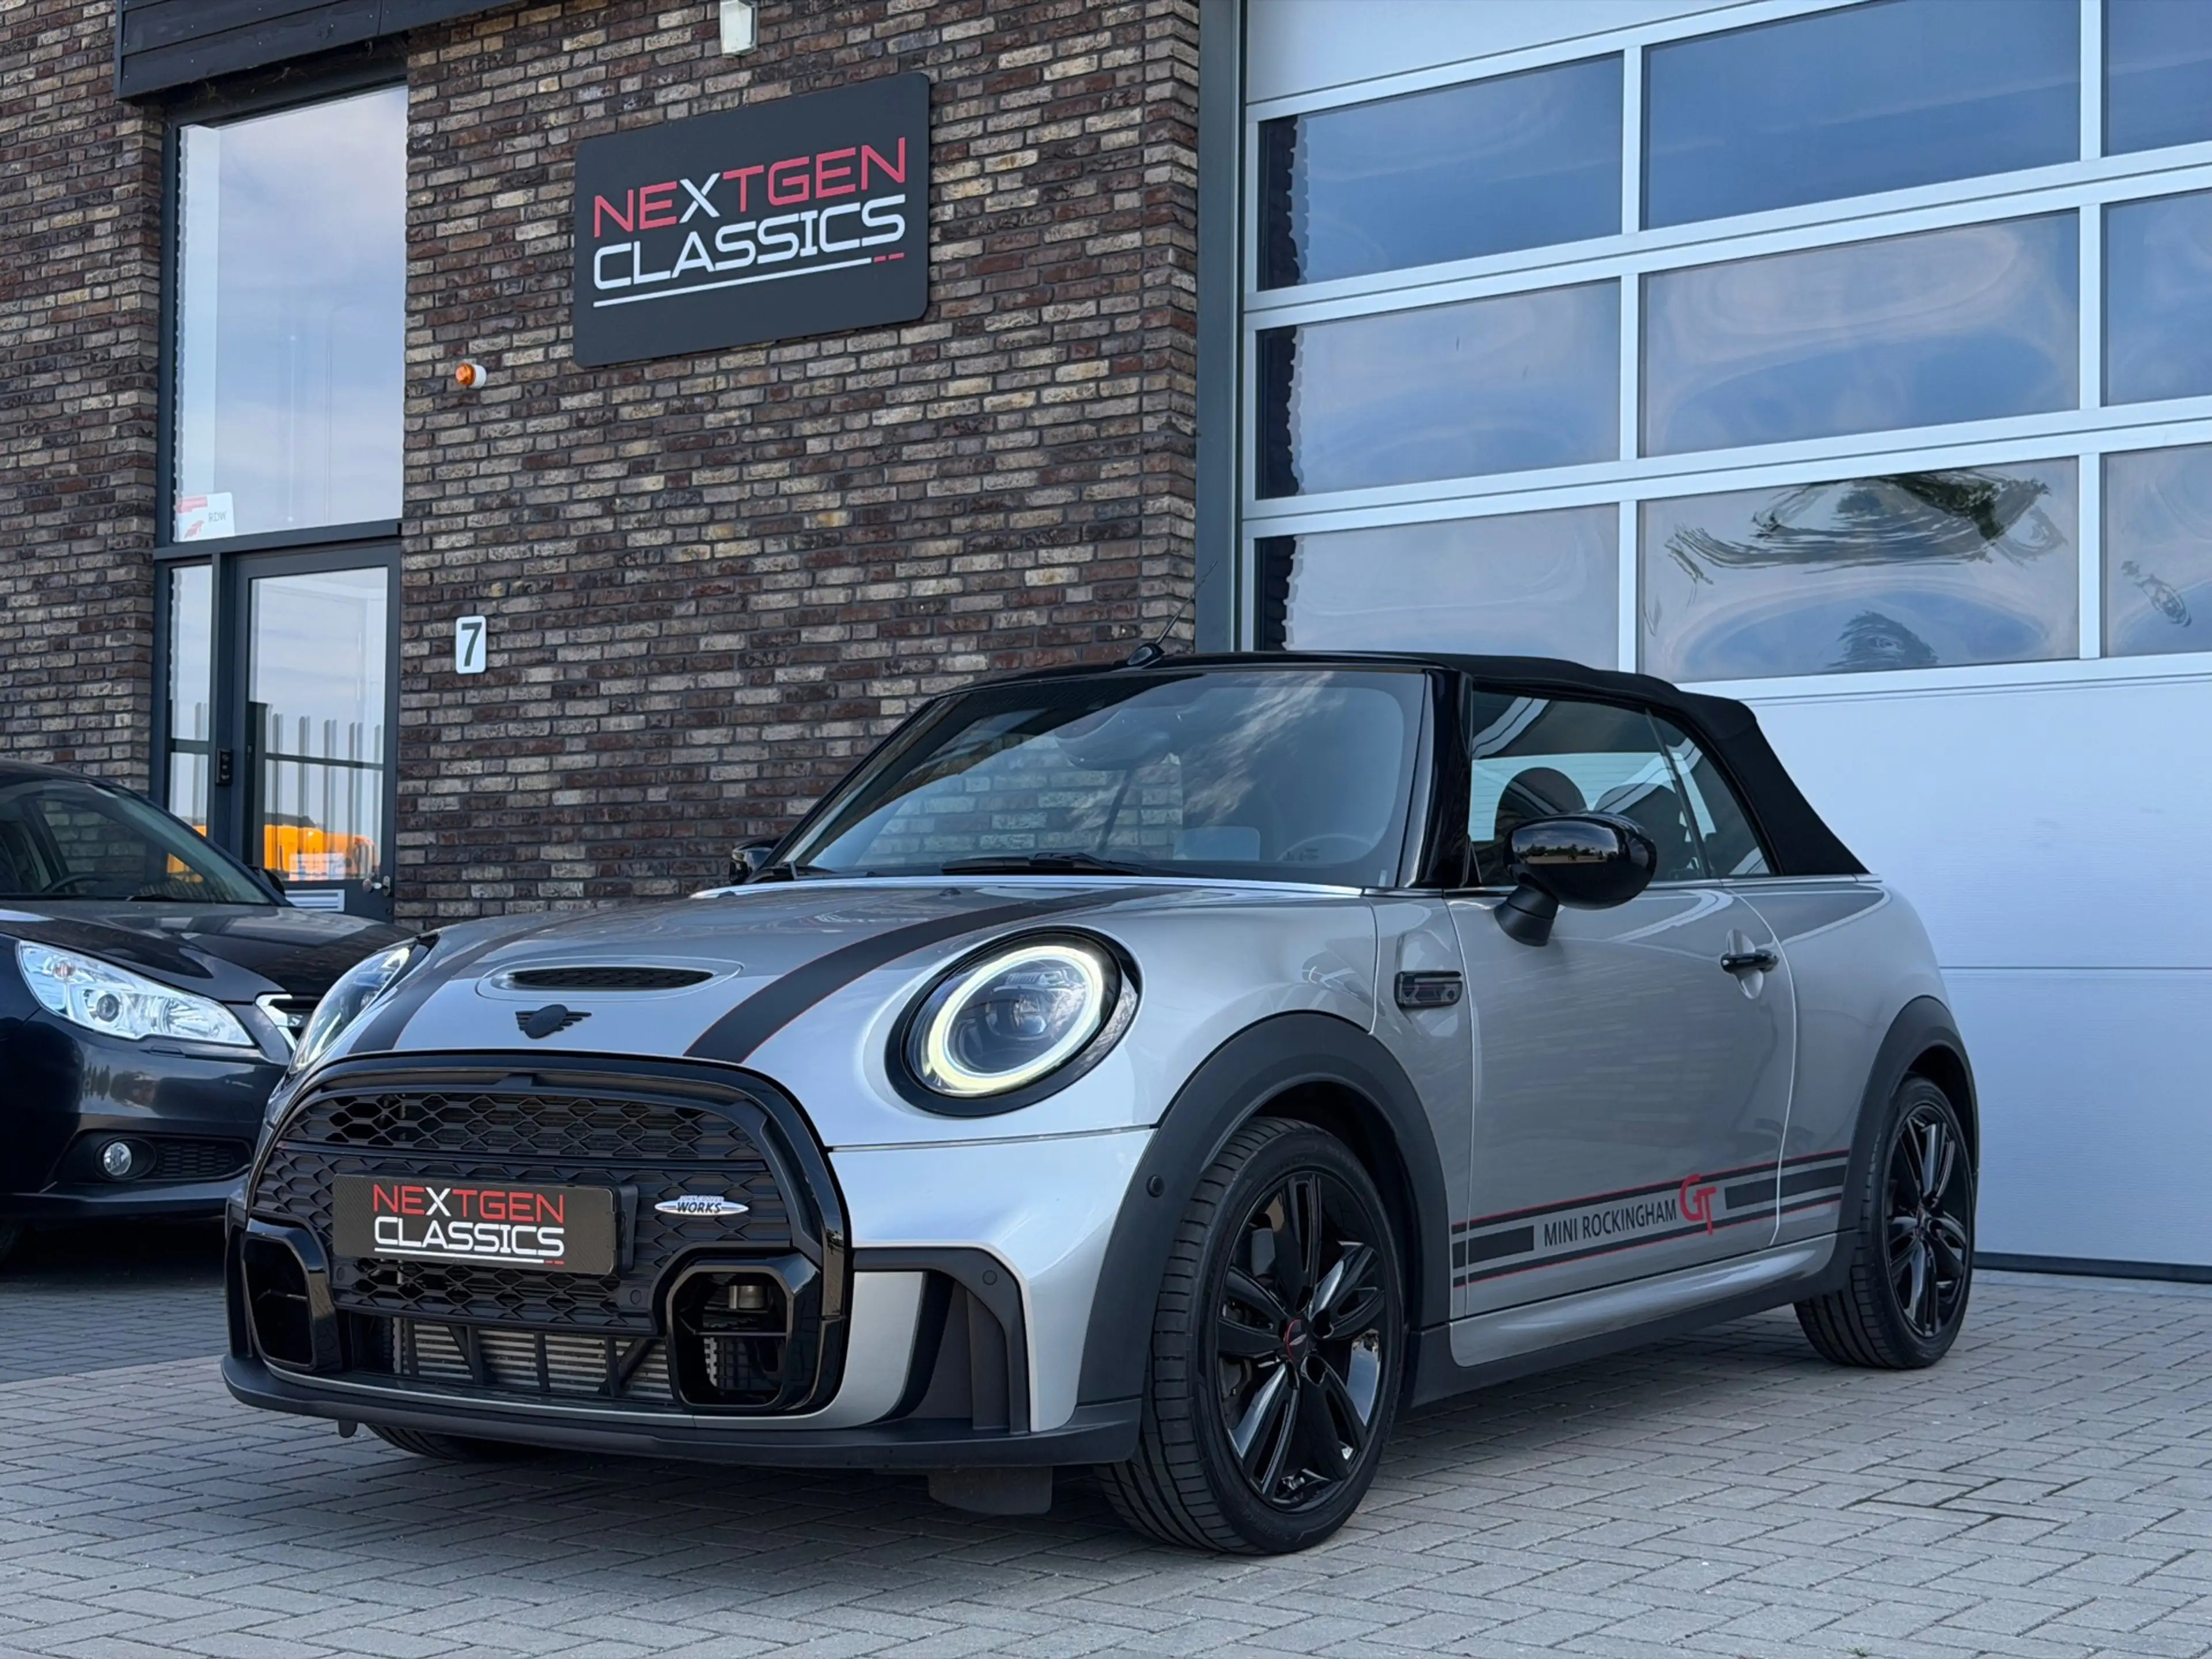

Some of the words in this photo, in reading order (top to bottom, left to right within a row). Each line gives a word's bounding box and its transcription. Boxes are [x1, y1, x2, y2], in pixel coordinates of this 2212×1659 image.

[594, 137, 906, 238] NEXTGEN
[593, 194, 906, 290] CLASSICS
[208, 511, 227, 522] RDW
[461, 622, 482, 667] 7
[373, 1184, 565, 1224] NEXTGEN
[677, 1202, 722, 1214] WORKS
[1544, 1218, 1578, 1248] MINI
[1582, 1198, 1677, 1240] ROCKINGHAM
[1679, 1174, 1717, 1236] GT
[374, 1215, 565, 1257] CLASSICS
